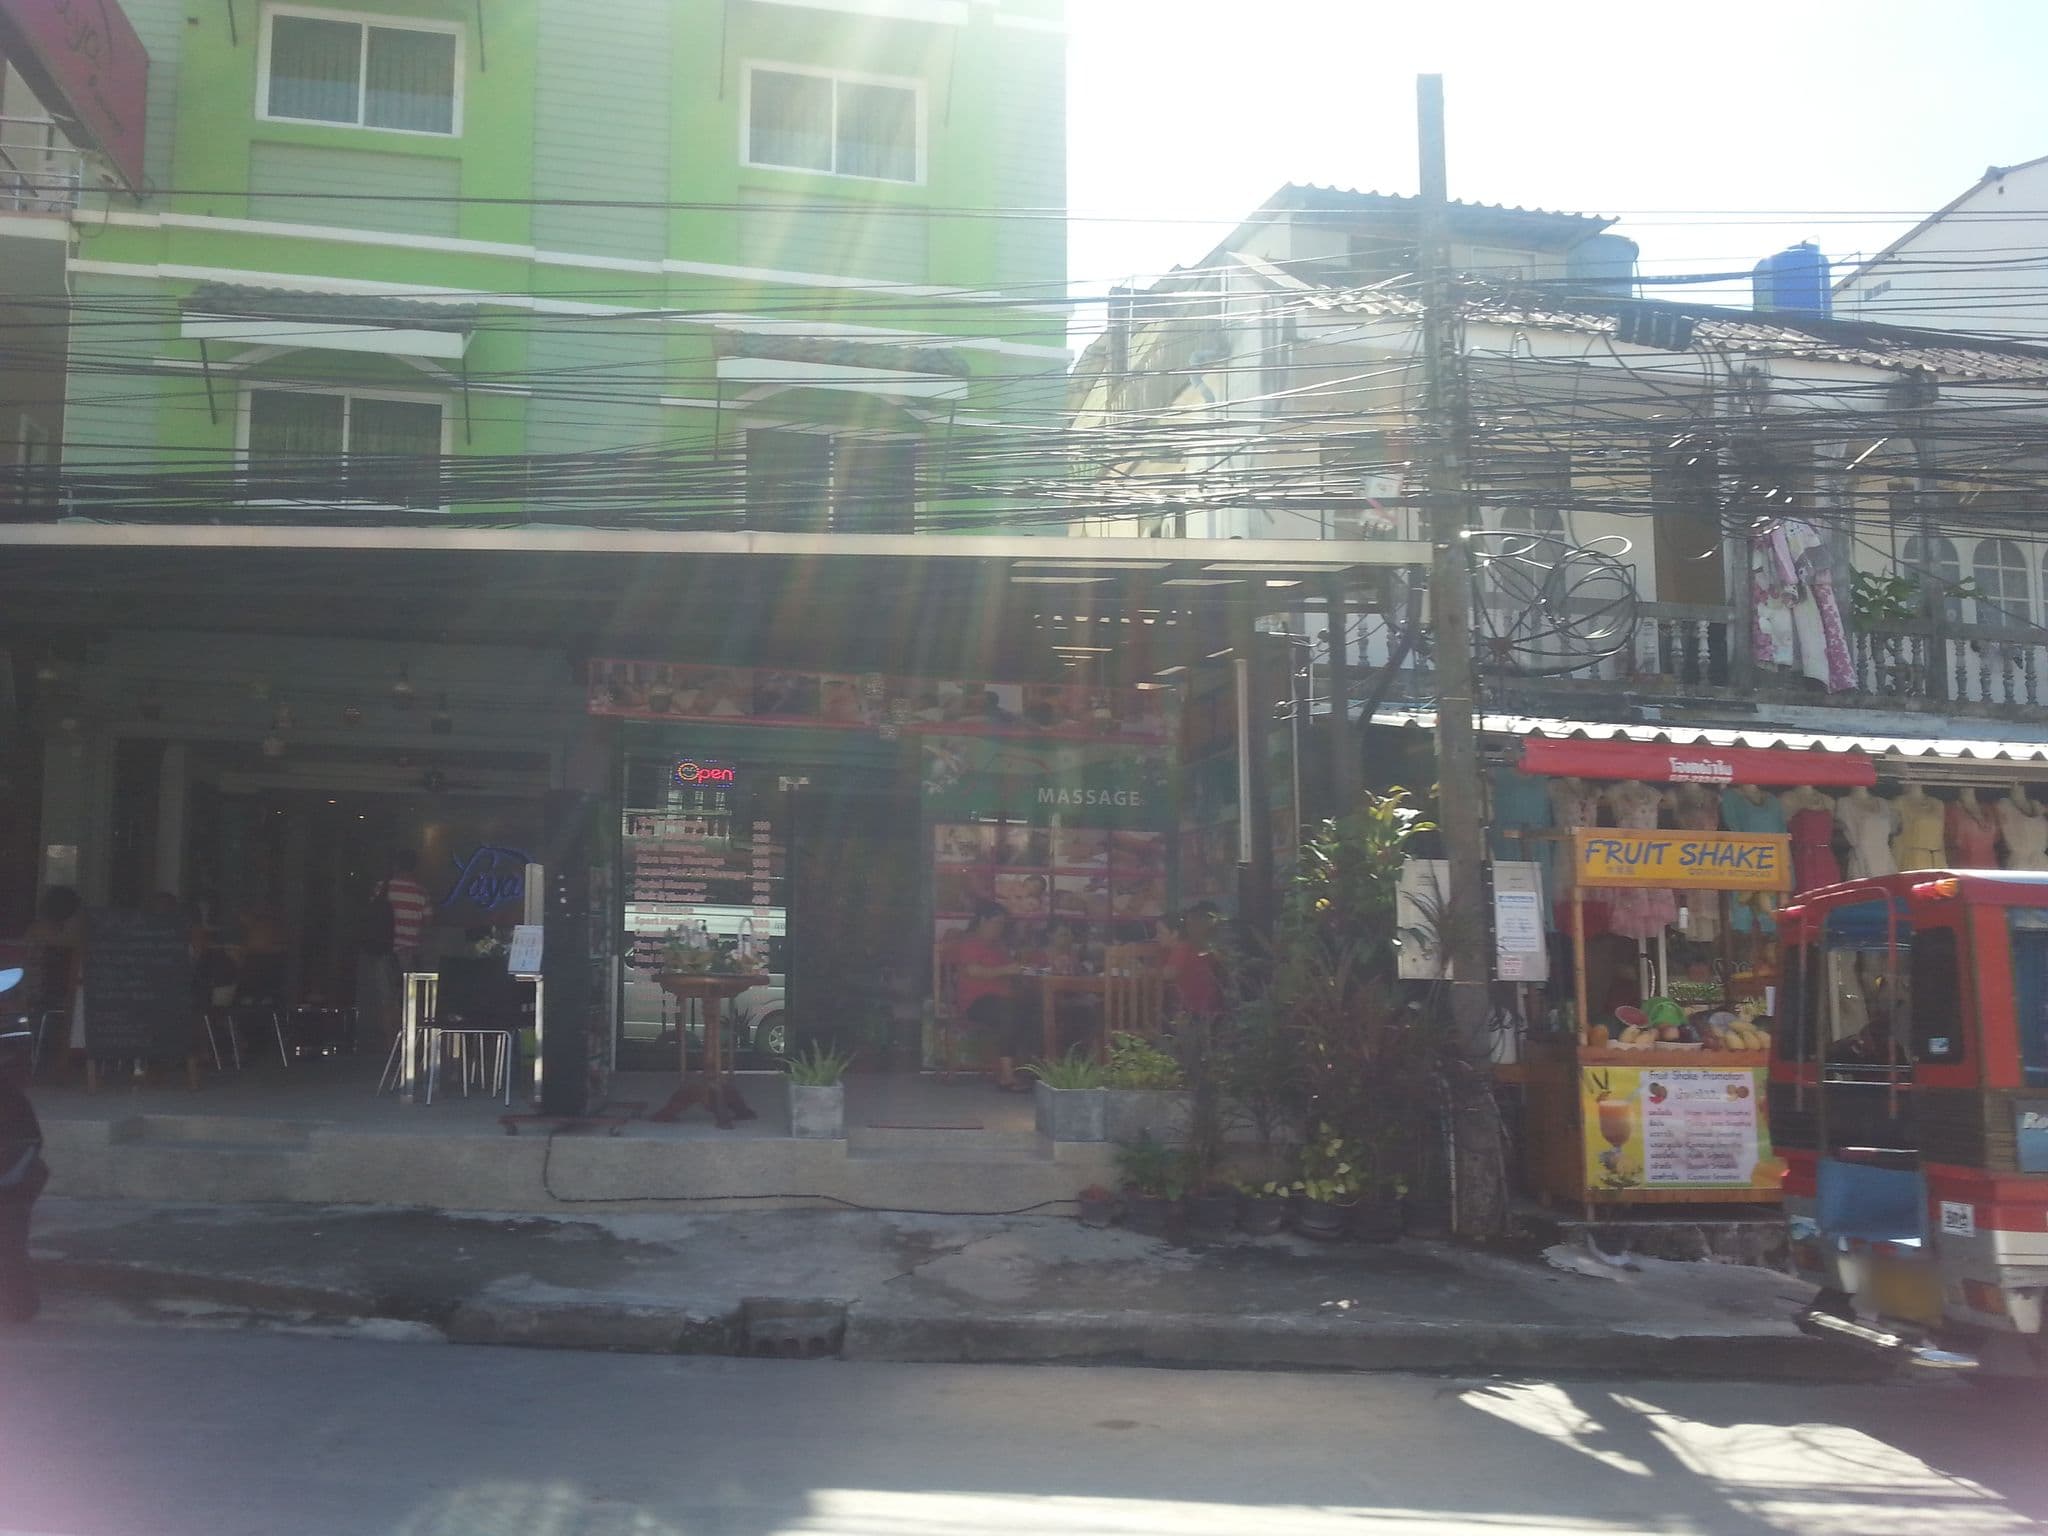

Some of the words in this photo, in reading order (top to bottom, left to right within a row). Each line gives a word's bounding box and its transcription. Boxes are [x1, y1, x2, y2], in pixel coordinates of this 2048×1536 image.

[677, 762, 735, 783] Open
[1037, 788, 1142, 807] MASSAGE
[1585, 839, 1672, 865] FRUIT
[1678, 842, 1774, 869] SHAKE
[1649, 1071, 1668, 1081] Fruit
[1671, 1070, 1698, 1081] Shake
[1702, 1071, 1746, 1081] Promotion
